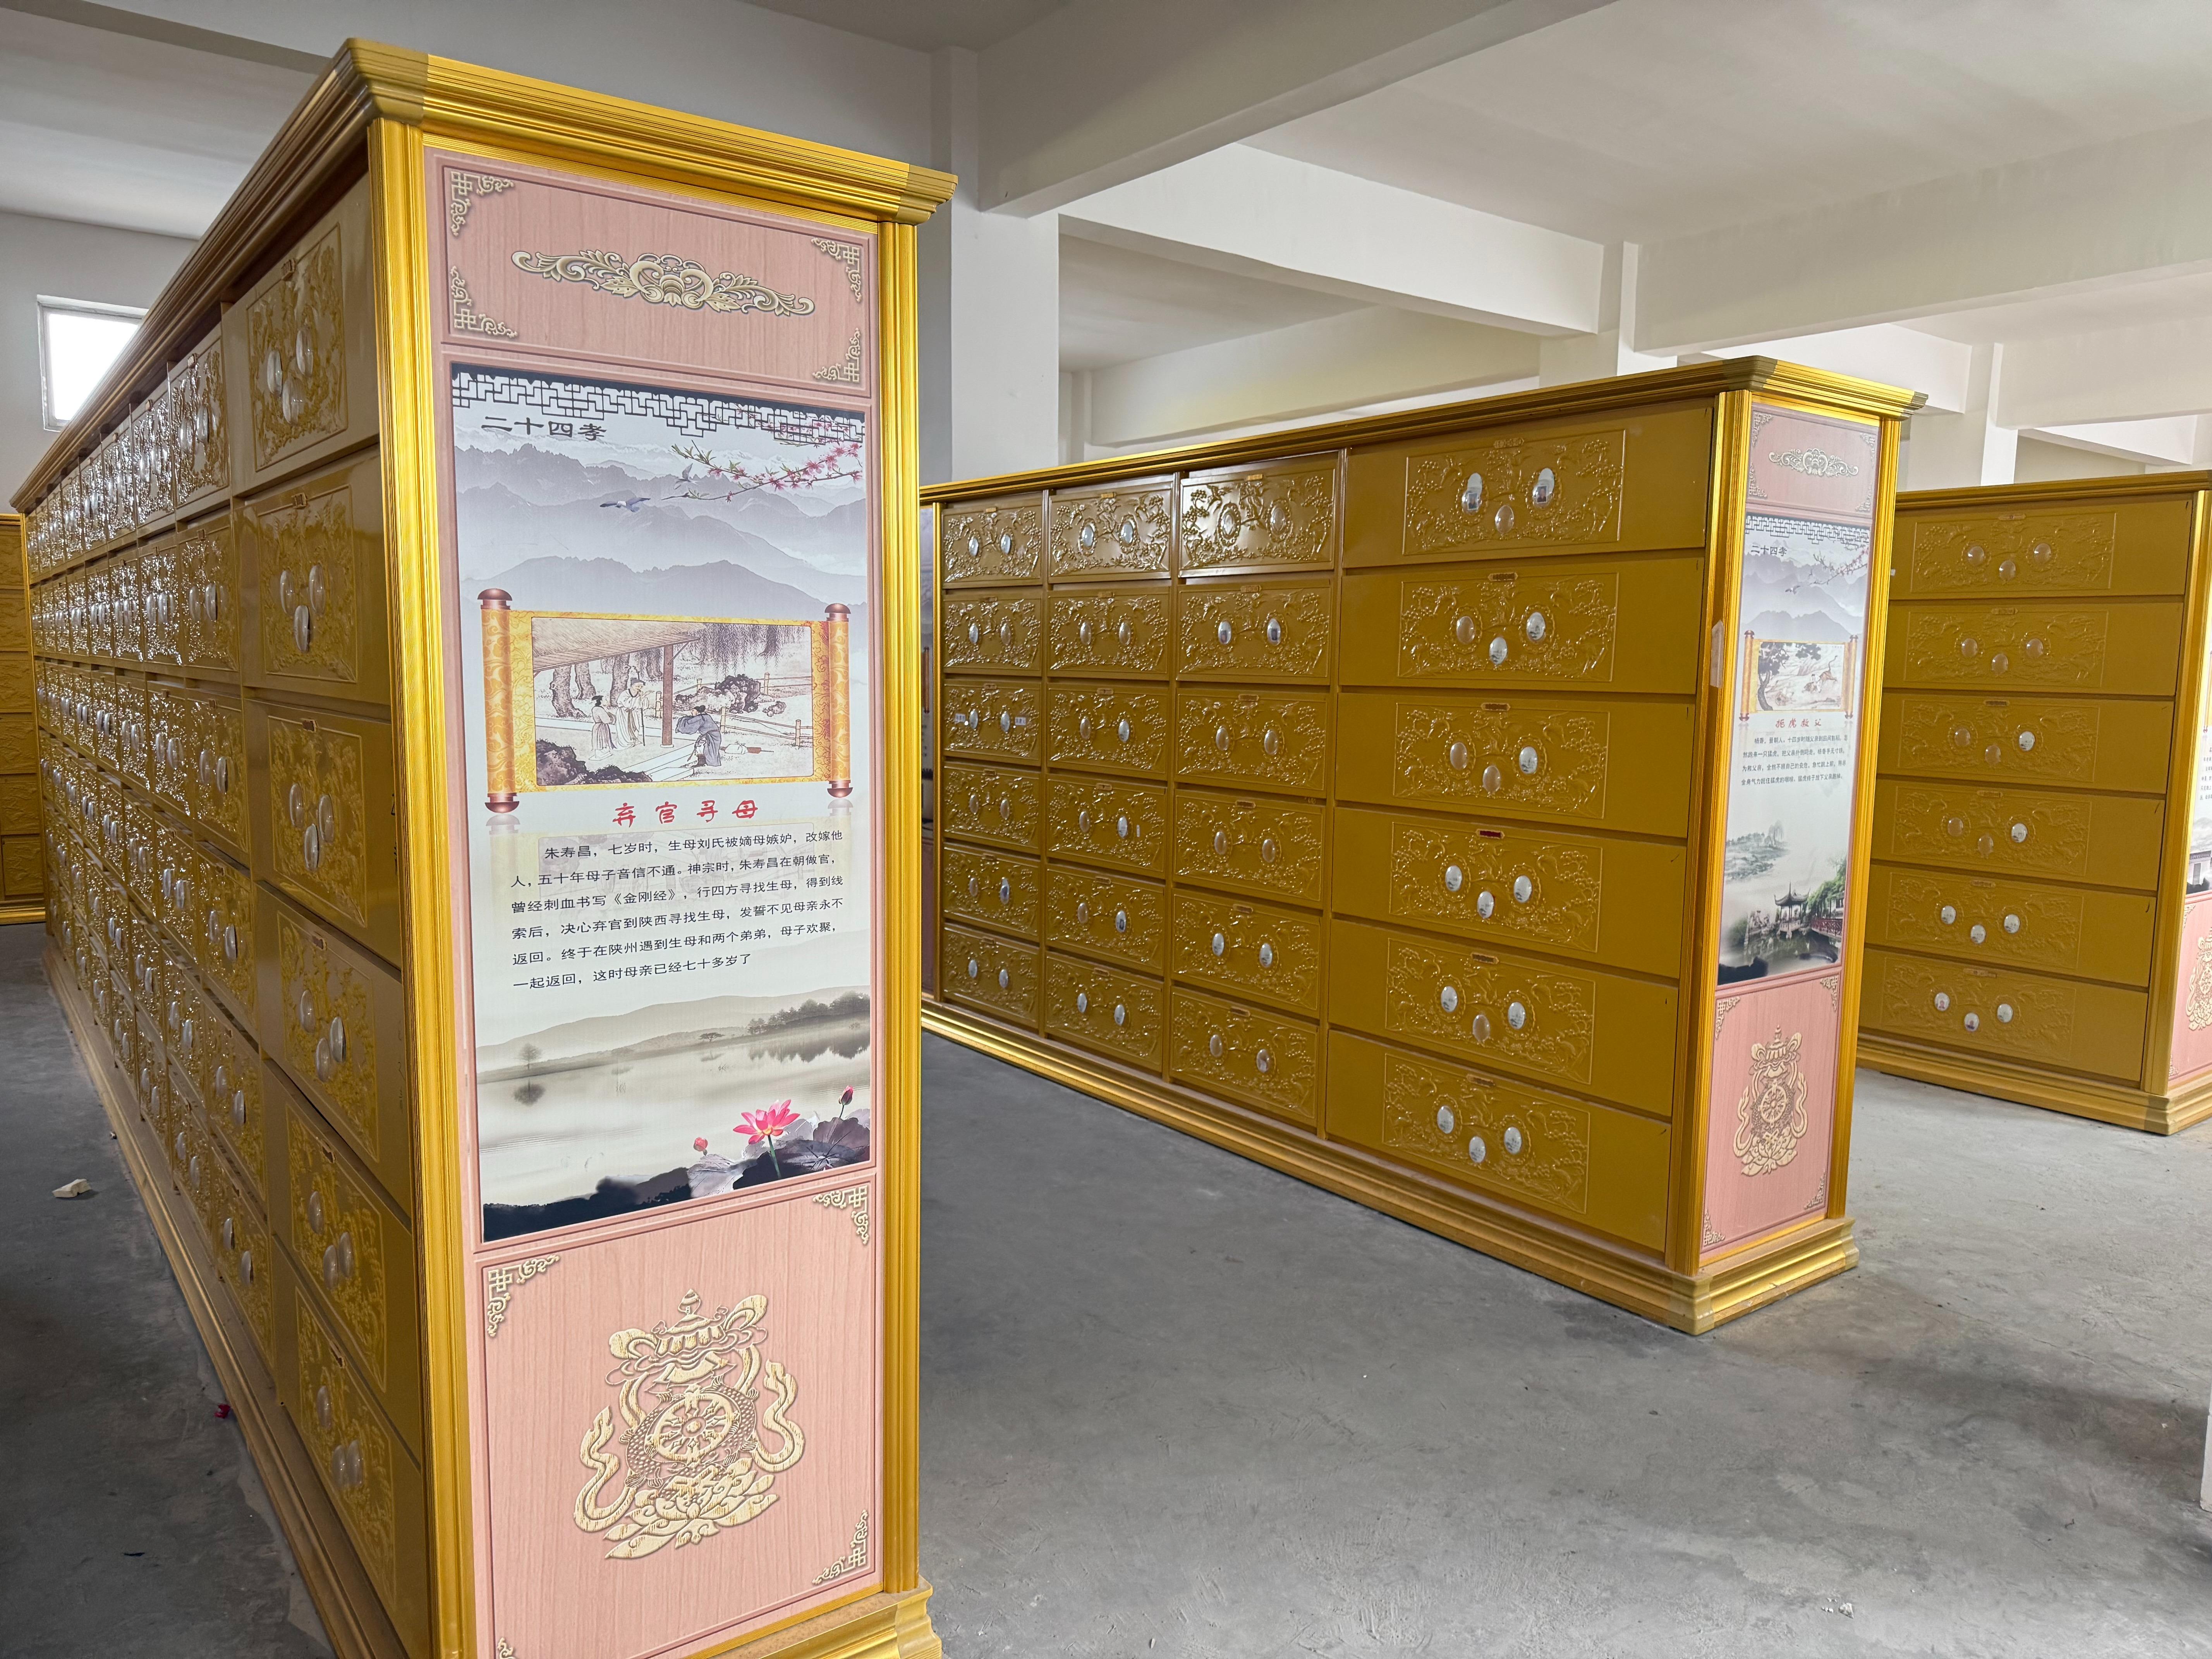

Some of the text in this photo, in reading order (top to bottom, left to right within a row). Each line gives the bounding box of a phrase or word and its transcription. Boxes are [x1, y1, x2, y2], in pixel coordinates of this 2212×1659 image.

[481, 416, 606, 441] 二十四孝
[1751, 545, 1787, 556] 二十四孝
[613, 800, 758, 827] 弃官寻母
[544, 830, 843, 859] 朱寿昌，七岁时，生母刘氏被嫡母嫉妒，改嫁他
[511, 854, 835, 888] 人，五十年母子音信不通。神宗时，朱寿昌在朝做官，
[512, 876, 843, 914] 曾经刺血书写《金刚经》，行四方寻找生母，得到线
[512, 898, 843, 939] 索后，决心弃官到陕西寻找生母，发誓不见母亲永不
[512, 922, 835, 965] 返回。终于在陕州遇到生母和两个弟弟，母子欢聚，
[513, 953, 751, 989] 一起返回，这时母亲已经七十多岁了
